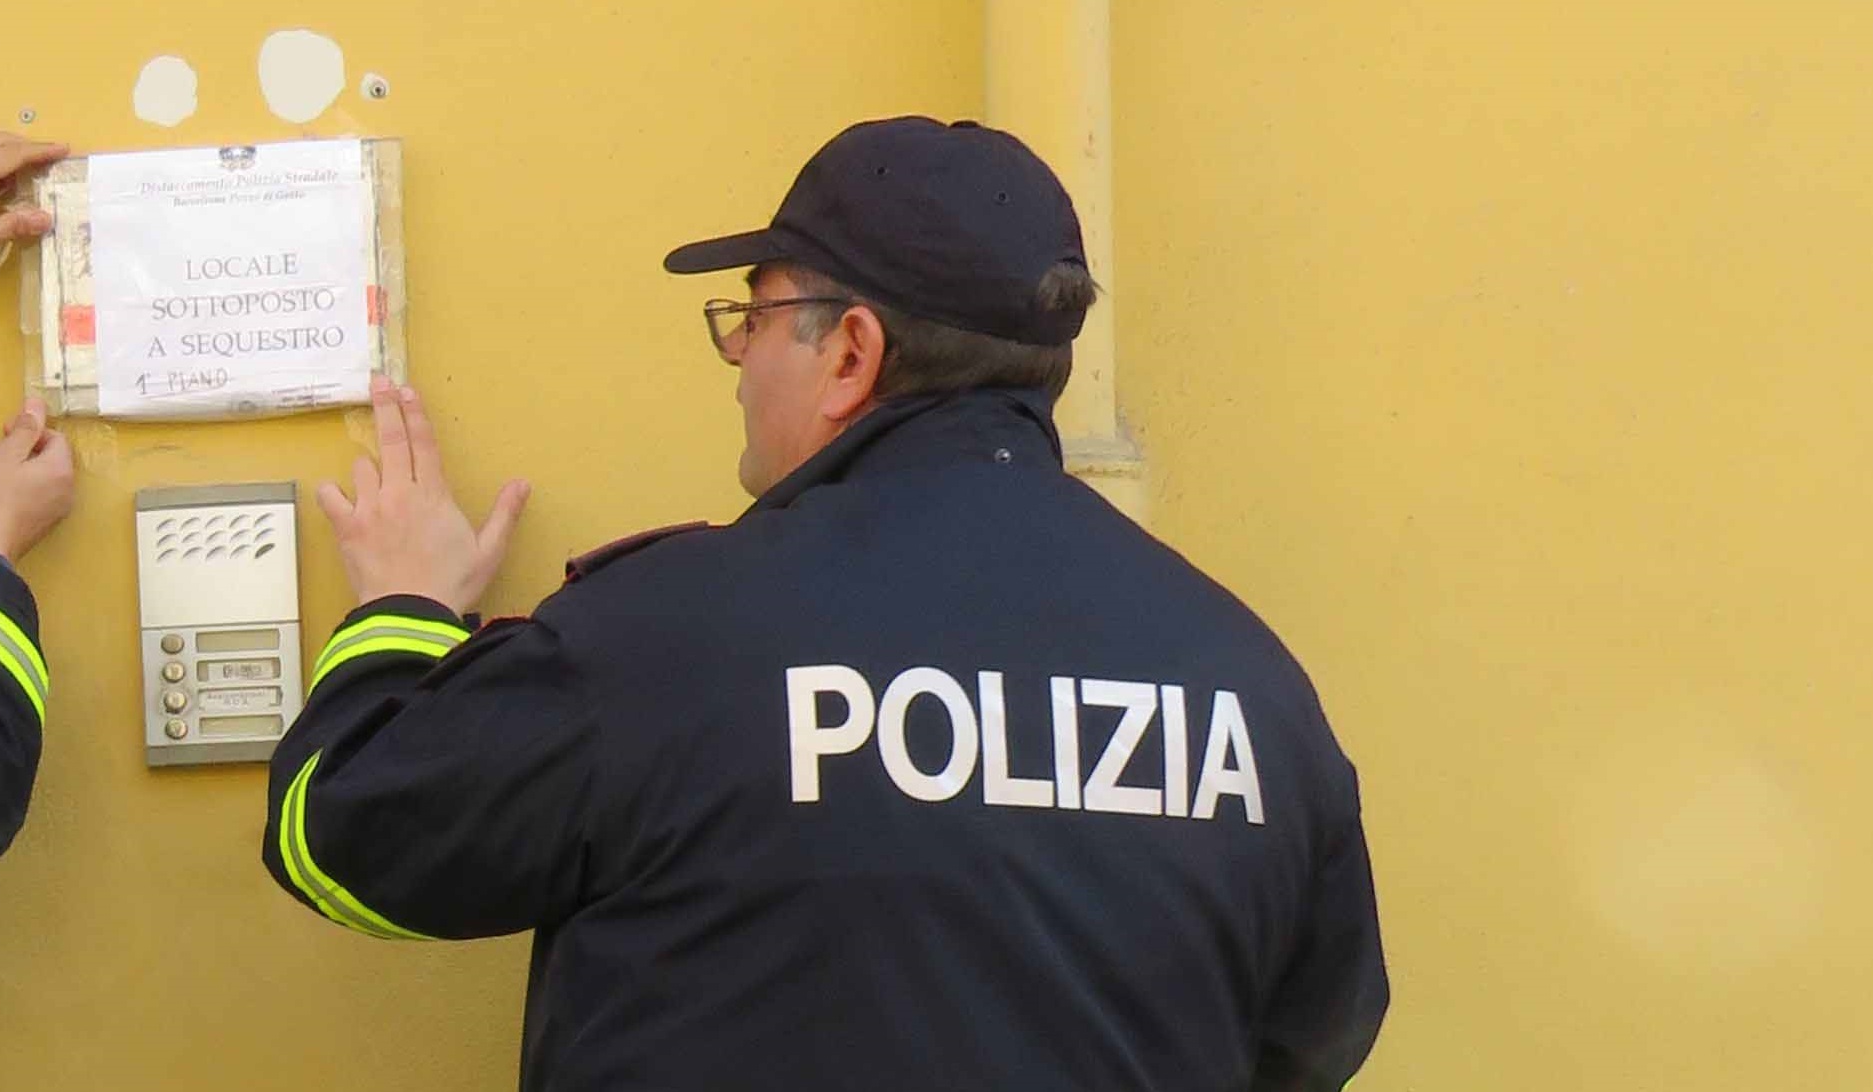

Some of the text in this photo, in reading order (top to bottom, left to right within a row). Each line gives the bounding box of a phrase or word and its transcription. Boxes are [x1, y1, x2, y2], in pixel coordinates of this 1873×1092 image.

[186, 253, 298, 281] LOCALE
[151, 287, 335, 320] SOTTOPOSTO
[147, 326, 345, 358] A SEQUESTRO
[786, 664, 1265, 825] POLIZIA
